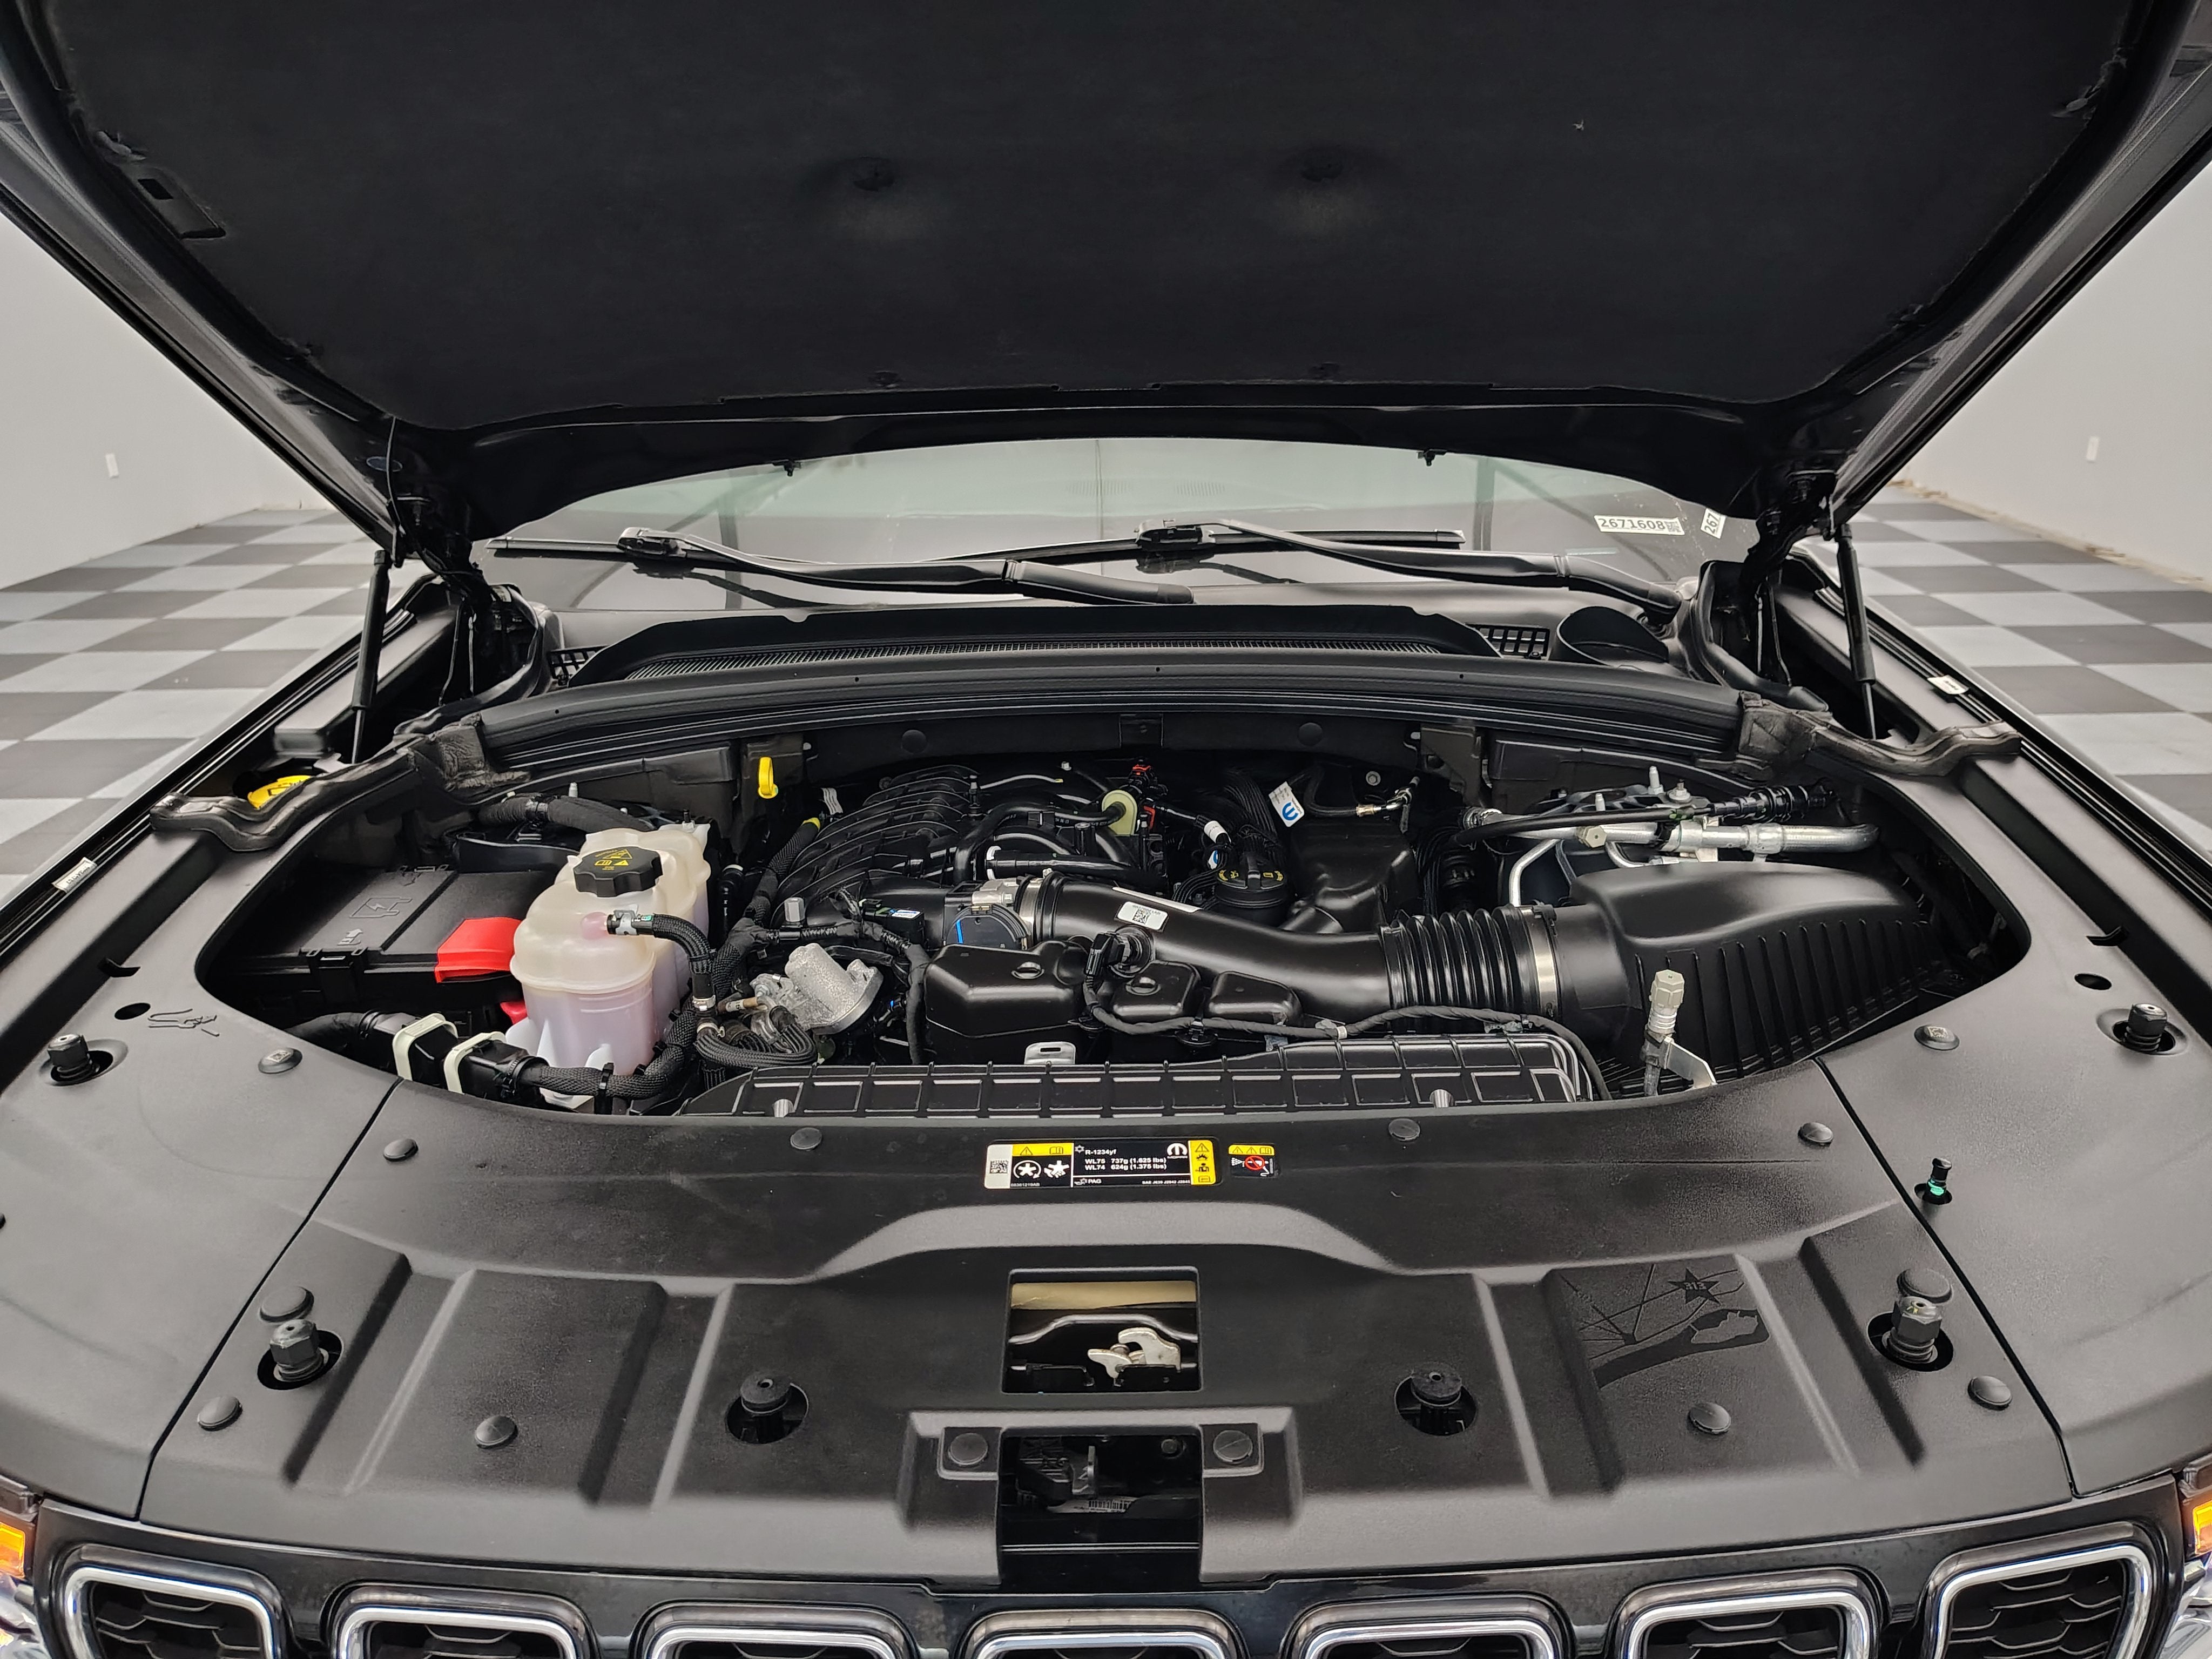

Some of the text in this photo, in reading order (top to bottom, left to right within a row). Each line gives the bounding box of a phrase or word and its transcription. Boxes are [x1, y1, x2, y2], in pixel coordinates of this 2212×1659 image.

[1597, 518, 1665, 530] 2671608
[1704, 512, 1719, 534] 267
[1684, 1282, 1707, 1290] 313
